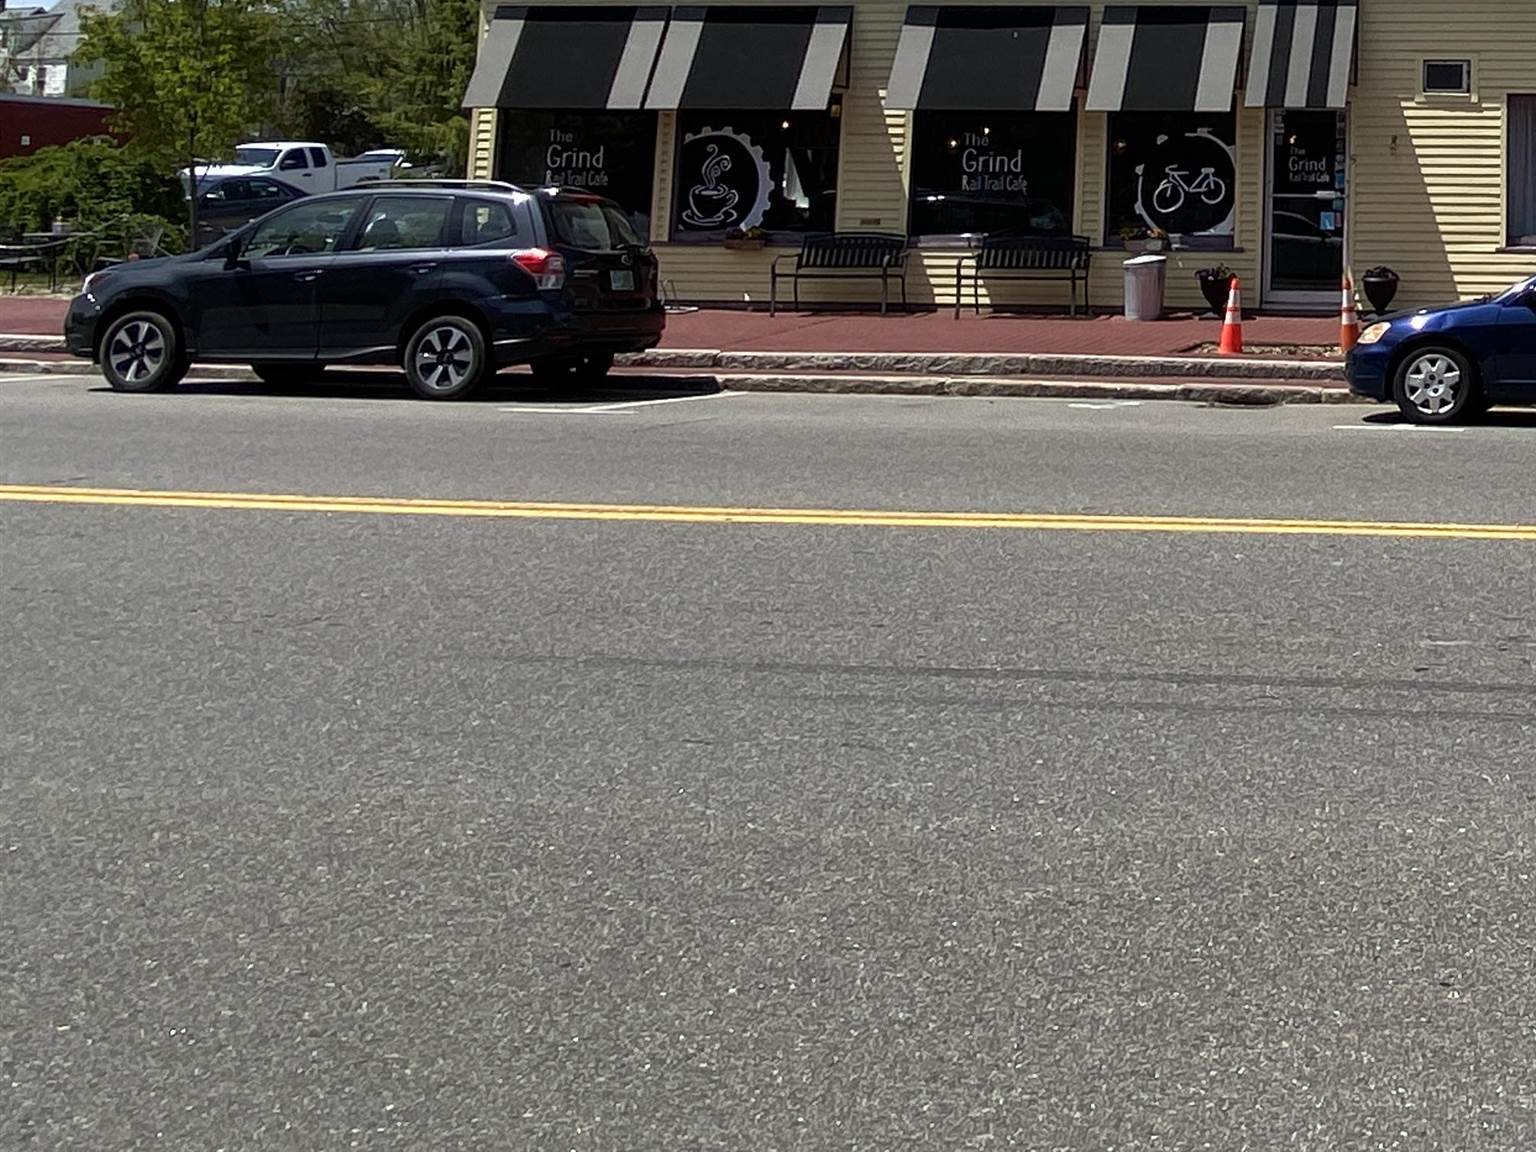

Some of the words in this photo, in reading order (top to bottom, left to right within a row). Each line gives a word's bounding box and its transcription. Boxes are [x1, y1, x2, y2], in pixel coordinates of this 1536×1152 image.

[549, 129, 574, 143] The
[964, 132, 989, 146] The
[546, 144, 604, 168] Grind
[962, 148, 1022, 173] Grind
[1288, 156, 1327, 172] Grind
[962, 174, 982, 191] Rail
[984, 174, 1004, 191] Trail
